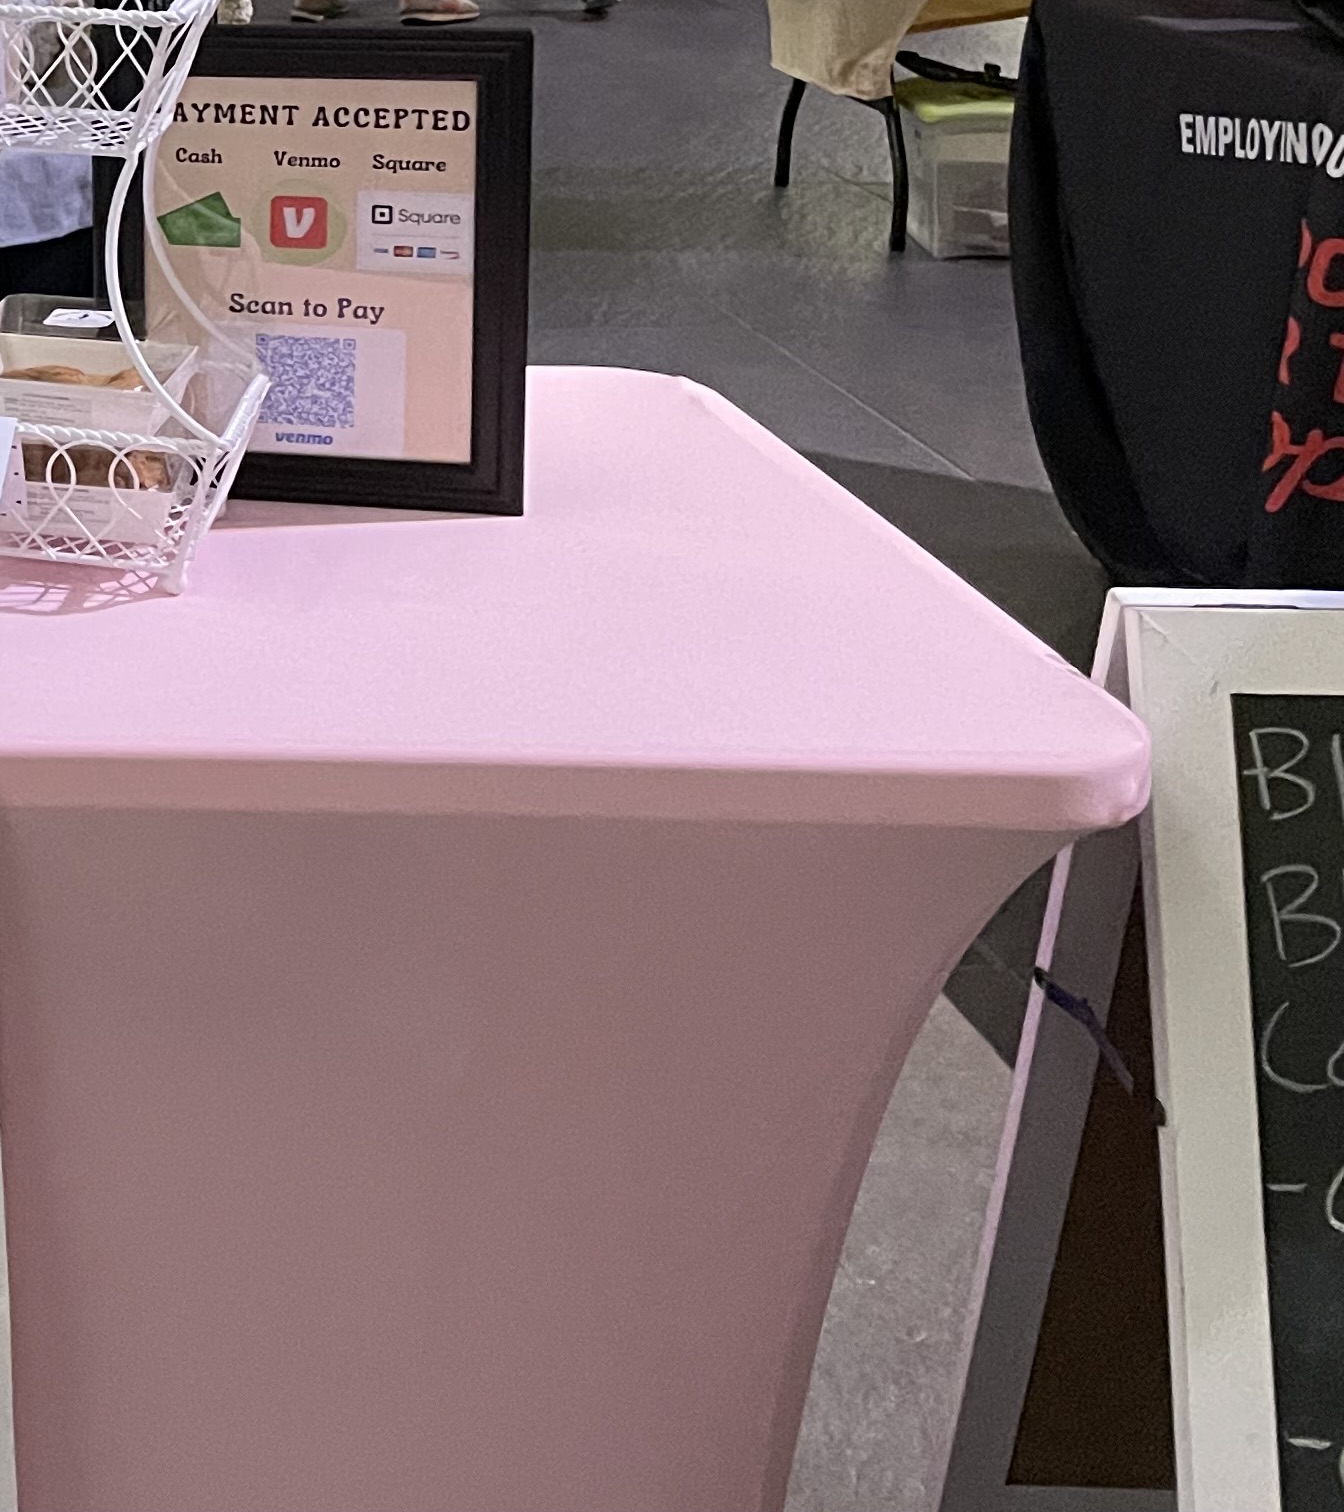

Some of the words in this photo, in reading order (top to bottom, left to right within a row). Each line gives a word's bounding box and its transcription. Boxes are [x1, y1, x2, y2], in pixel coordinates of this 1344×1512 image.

[155, 102, 300, 128] AYMENT
[312, 106, 472, 132] ACCEPTED
[175, 147, 223, 165] Cash
[273, 150, 341, 169] Venmo
[372, 154, 447, 173] Square
[398, 208, 462, 226] Square
[229, 293, 294, 317] Scan
[303, 296, 328, 318] to
[337, 298, 385, 325] Pay
[275, 431, 334, 446] venmo
